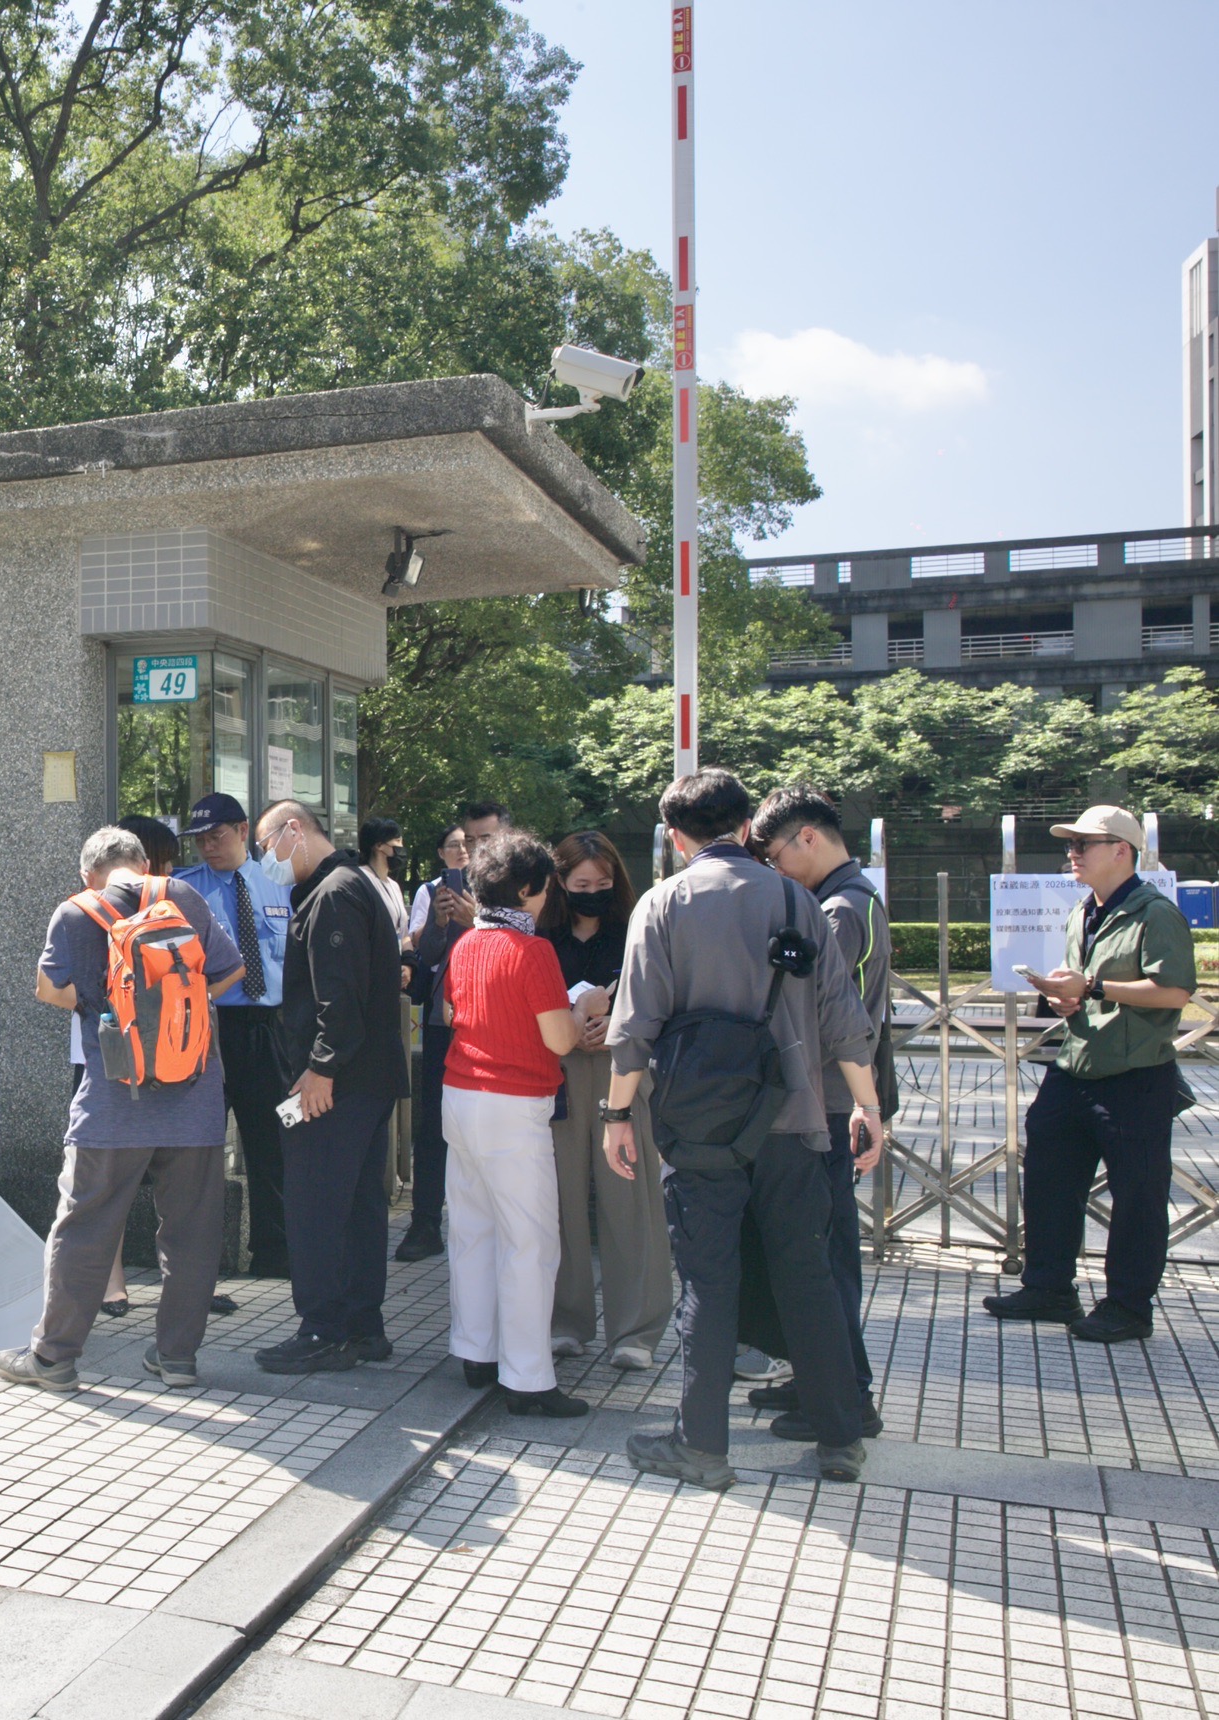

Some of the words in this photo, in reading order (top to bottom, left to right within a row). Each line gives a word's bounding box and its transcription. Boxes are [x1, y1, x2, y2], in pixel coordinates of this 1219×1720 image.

[151, 657, 193, 667] 中央路四段
[160, 672, 186, 696] 49
[1045, 880, 1090, 889] 2026年股
